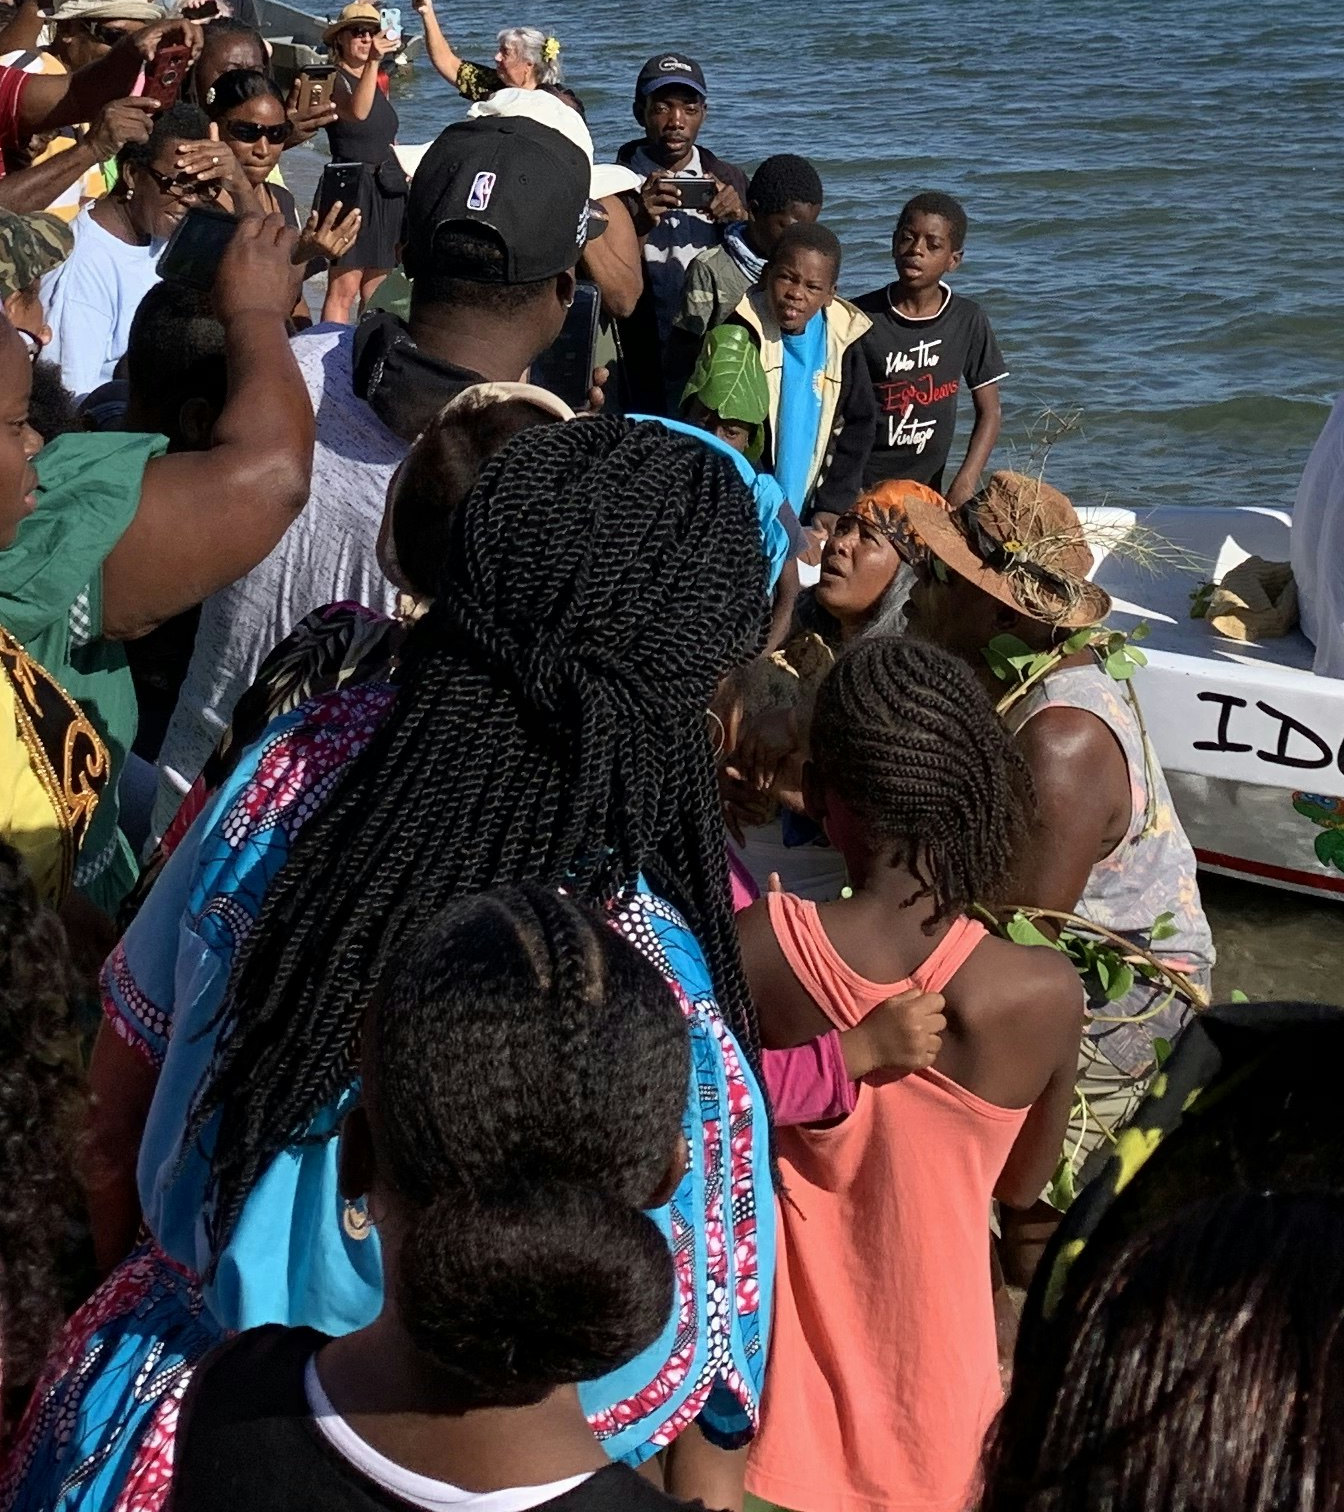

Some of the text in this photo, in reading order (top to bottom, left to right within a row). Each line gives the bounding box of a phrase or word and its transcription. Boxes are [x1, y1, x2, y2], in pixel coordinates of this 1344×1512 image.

[909, 339, 943, 368] The
[916, 373, 960, 405] Jeans
[888, 403, 937, 455] Vintage
